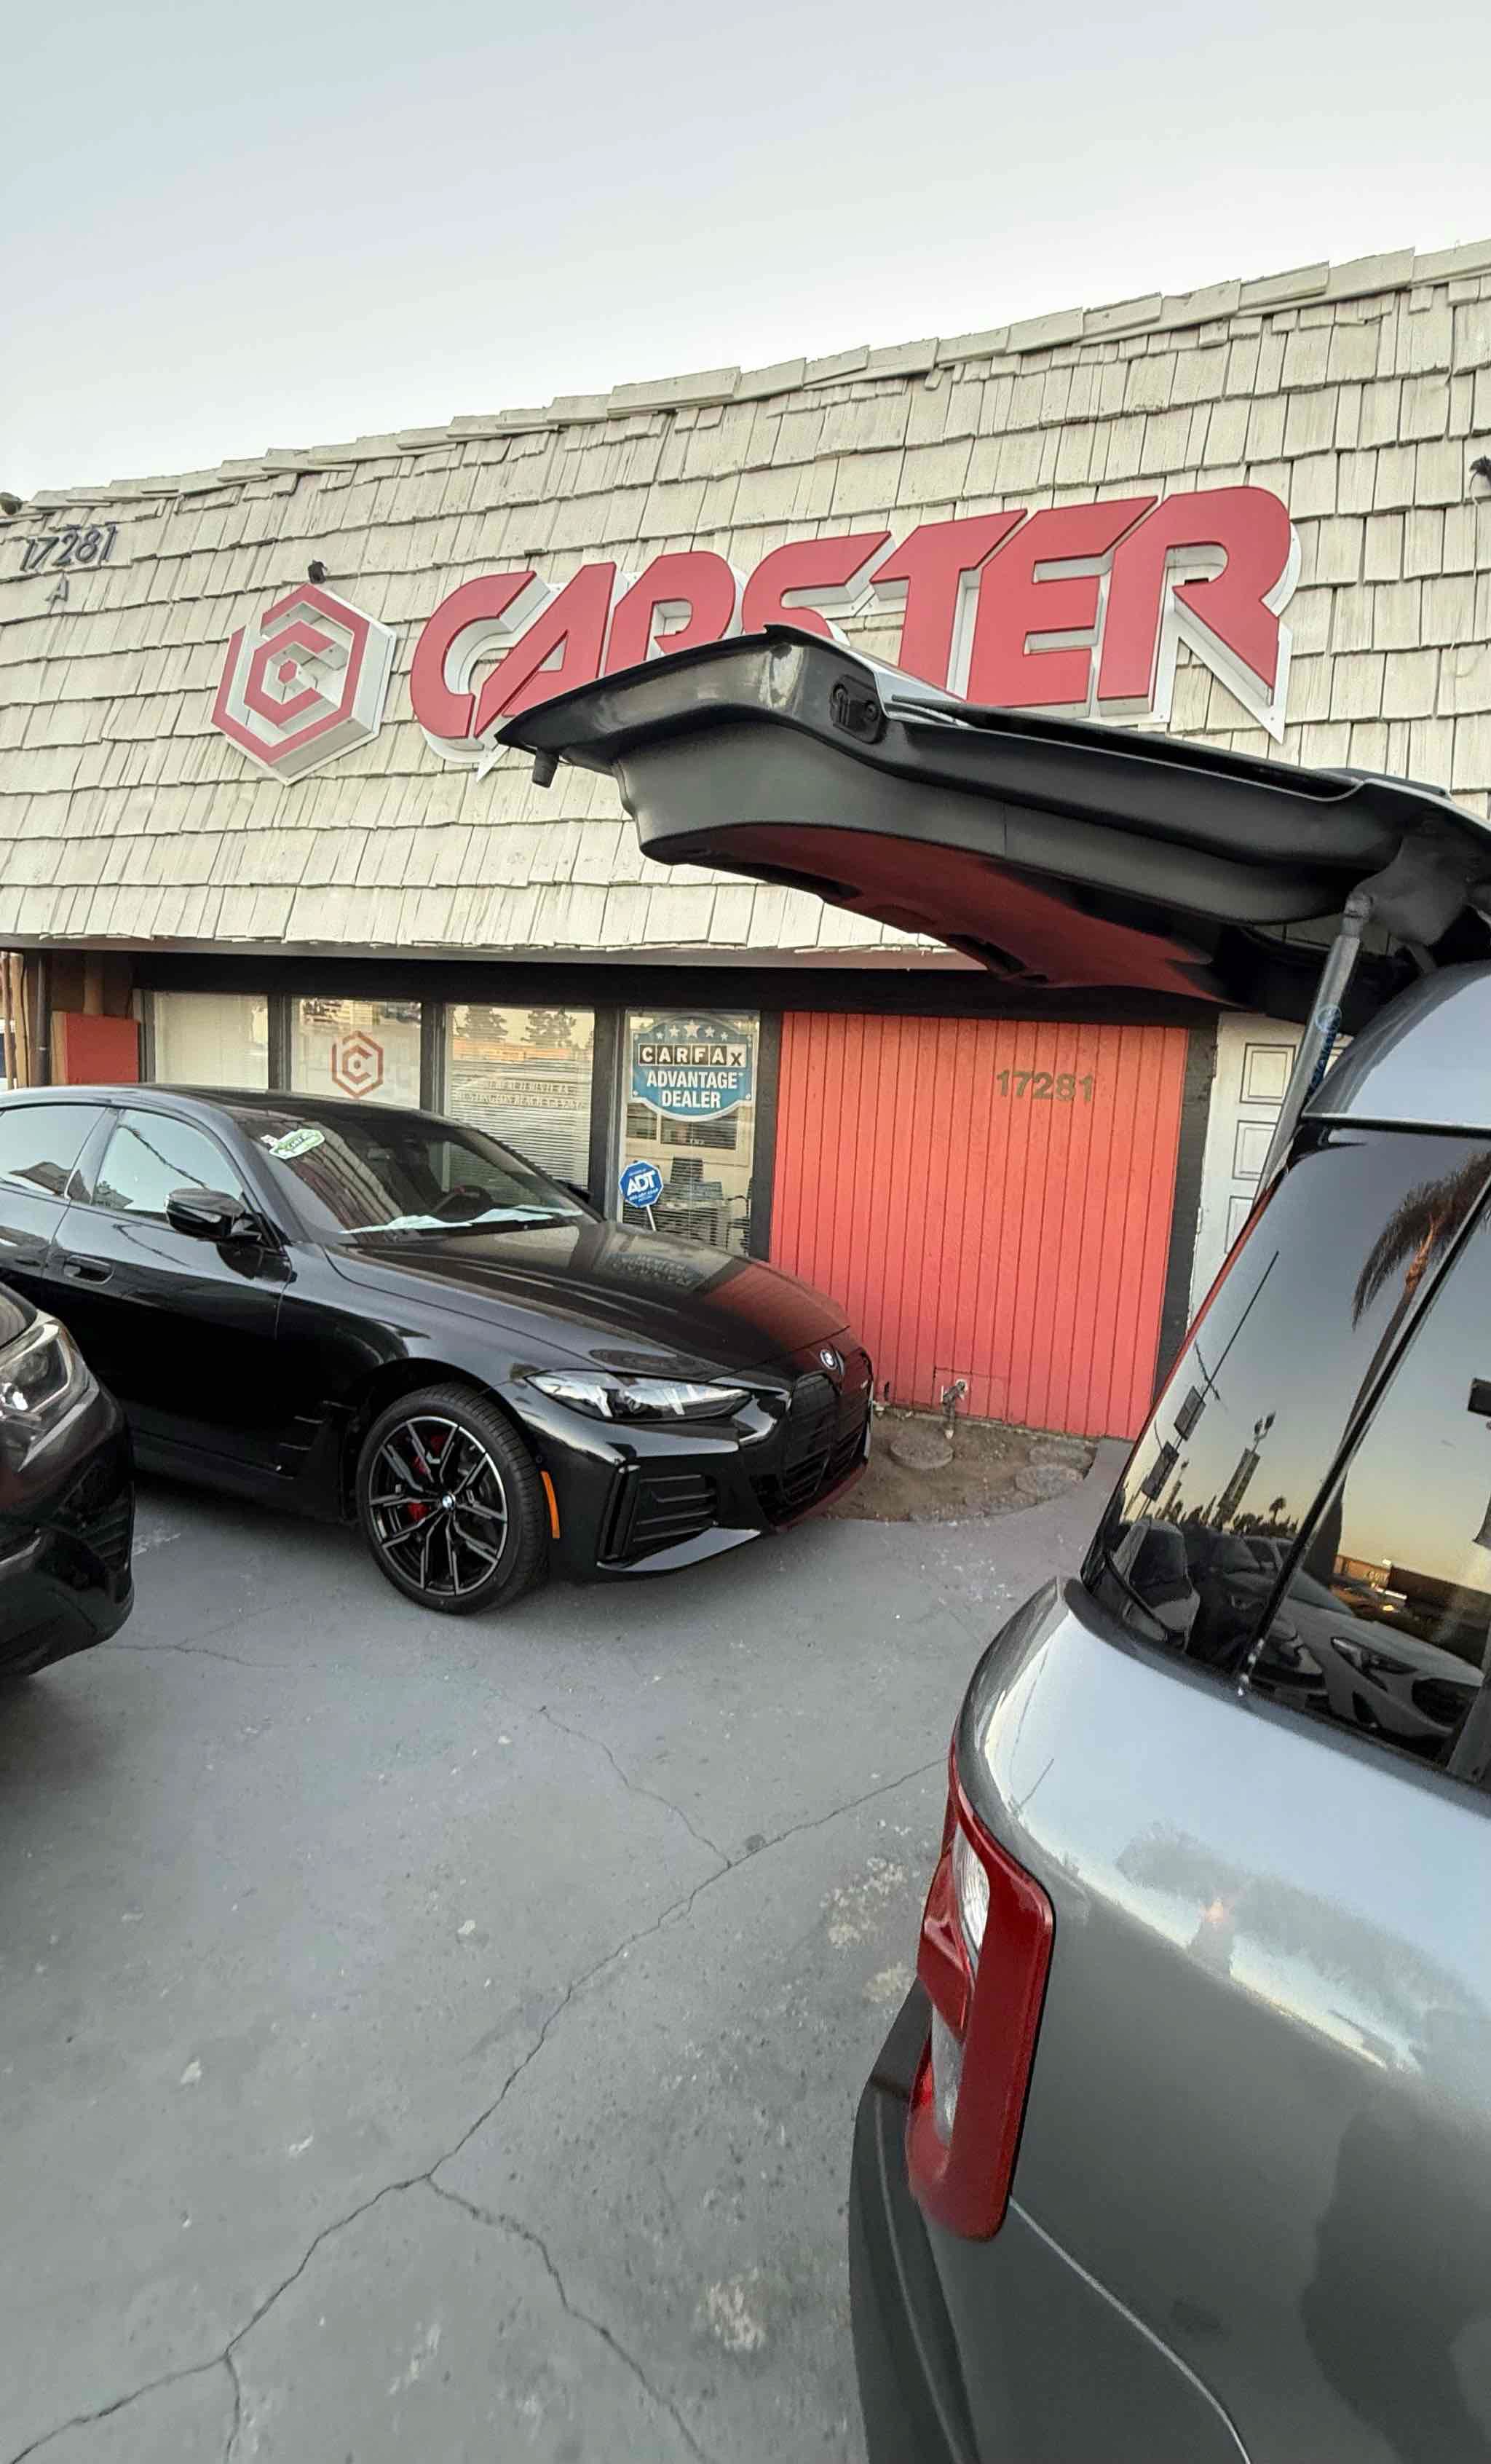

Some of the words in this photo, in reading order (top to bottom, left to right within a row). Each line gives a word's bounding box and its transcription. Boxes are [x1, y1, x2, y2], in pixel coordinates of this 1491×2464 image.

[20, 524, 116, 572] 17281
[641, 1046, 742, 1066] CARFAX
[646, 1070, 738, 1089] ADVANTAGE
[996, 1069, 1093, 1103] 17281
[662, 1090, 721, 1109] DEALER
[627, 1169, 656, 1196] ADT
